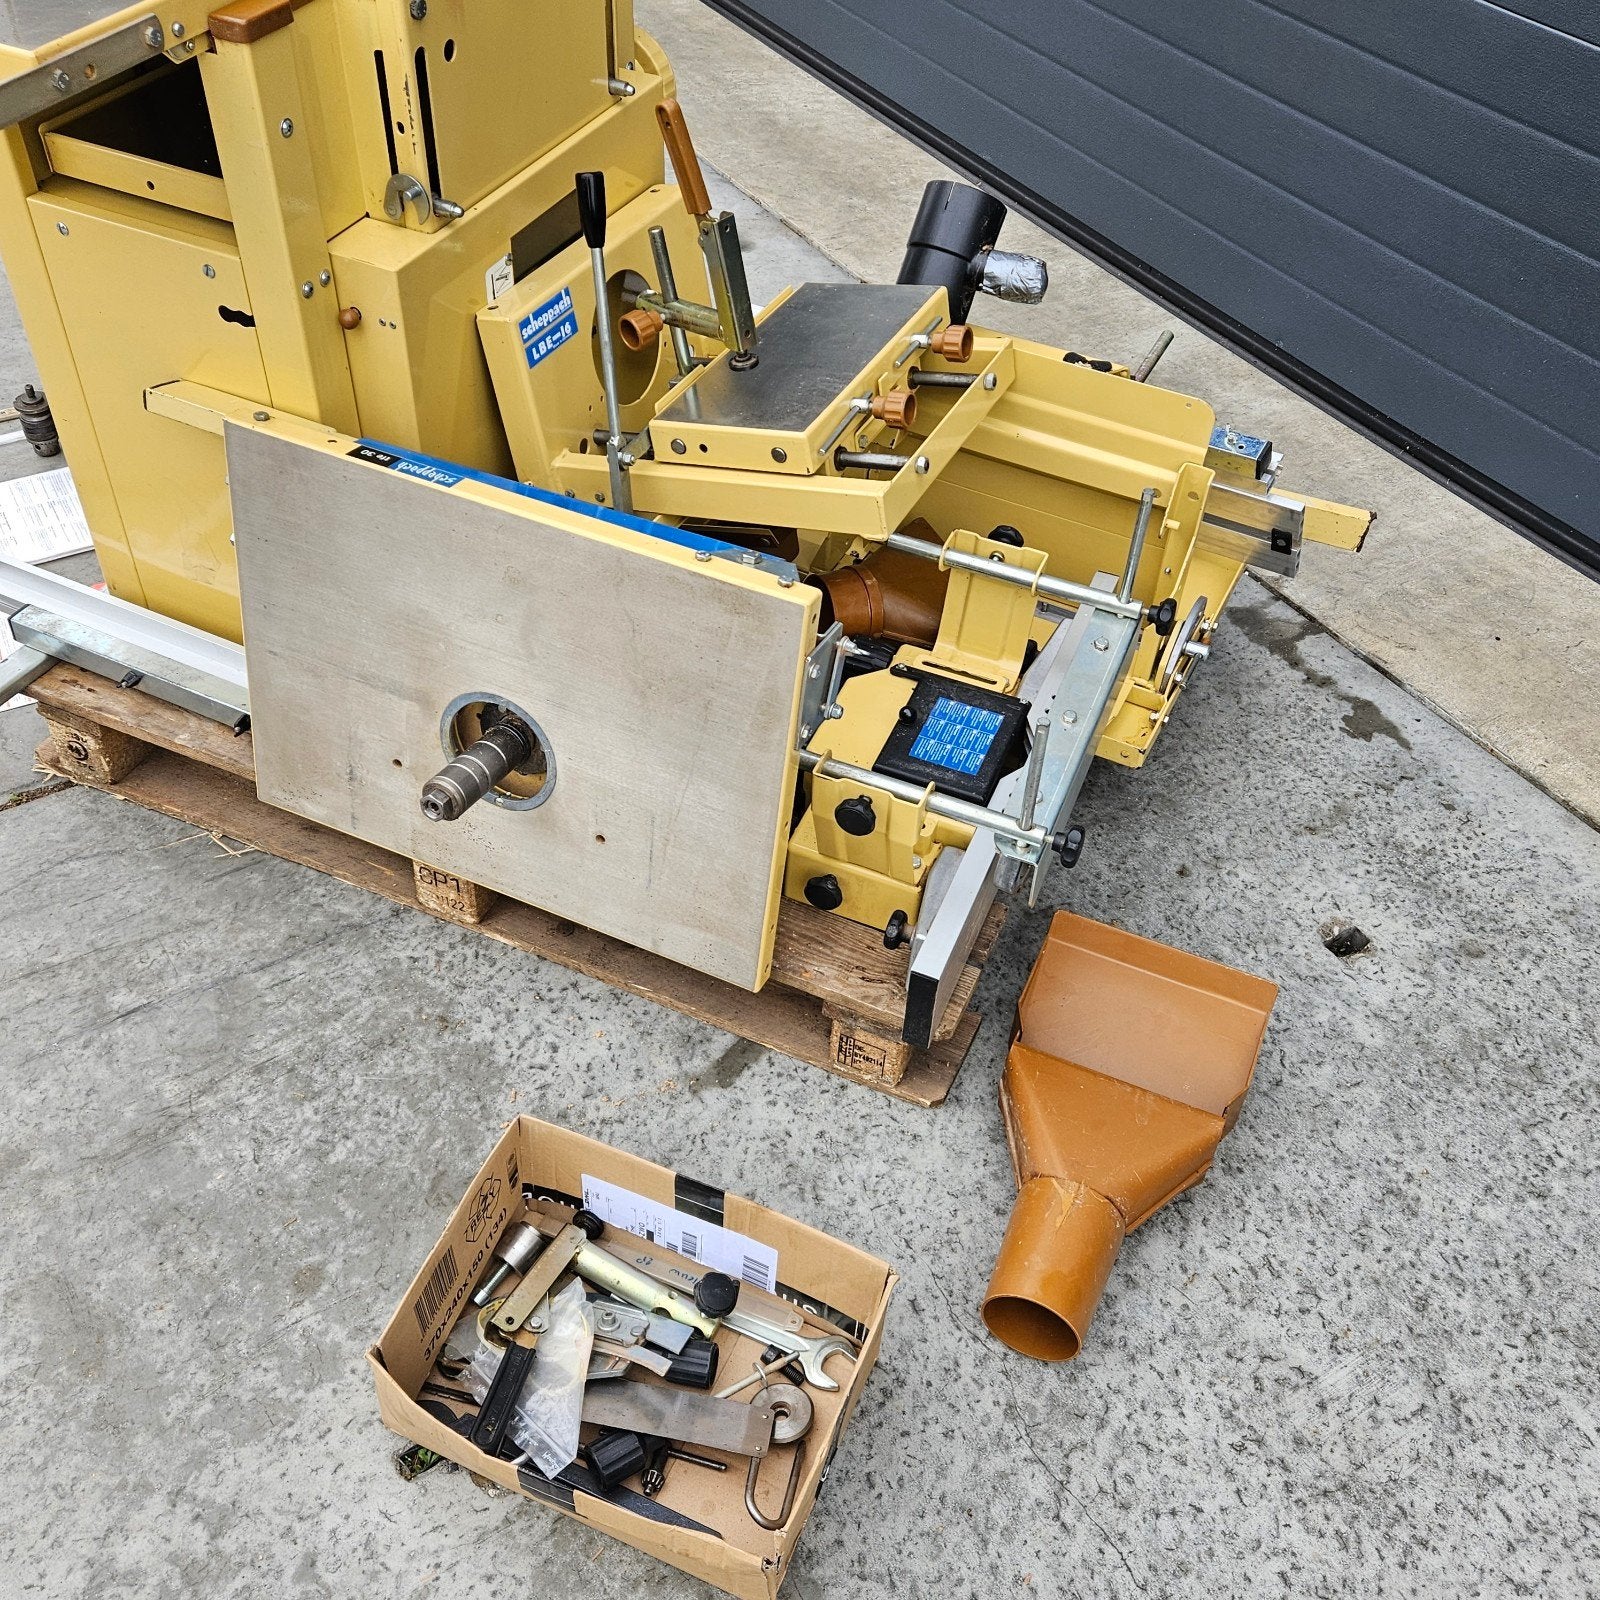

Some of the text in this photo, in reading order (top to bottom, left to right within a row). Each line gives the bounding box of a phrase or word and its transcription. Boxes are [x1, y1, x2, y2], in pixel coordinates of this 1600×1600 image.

[521, 289, 571, 340] scheppach
[360, 449, 376, 458] 30
[394, 461, 458, 484] scheppach
[424, 1207, 508, 1362] 370x240x150 (134)
